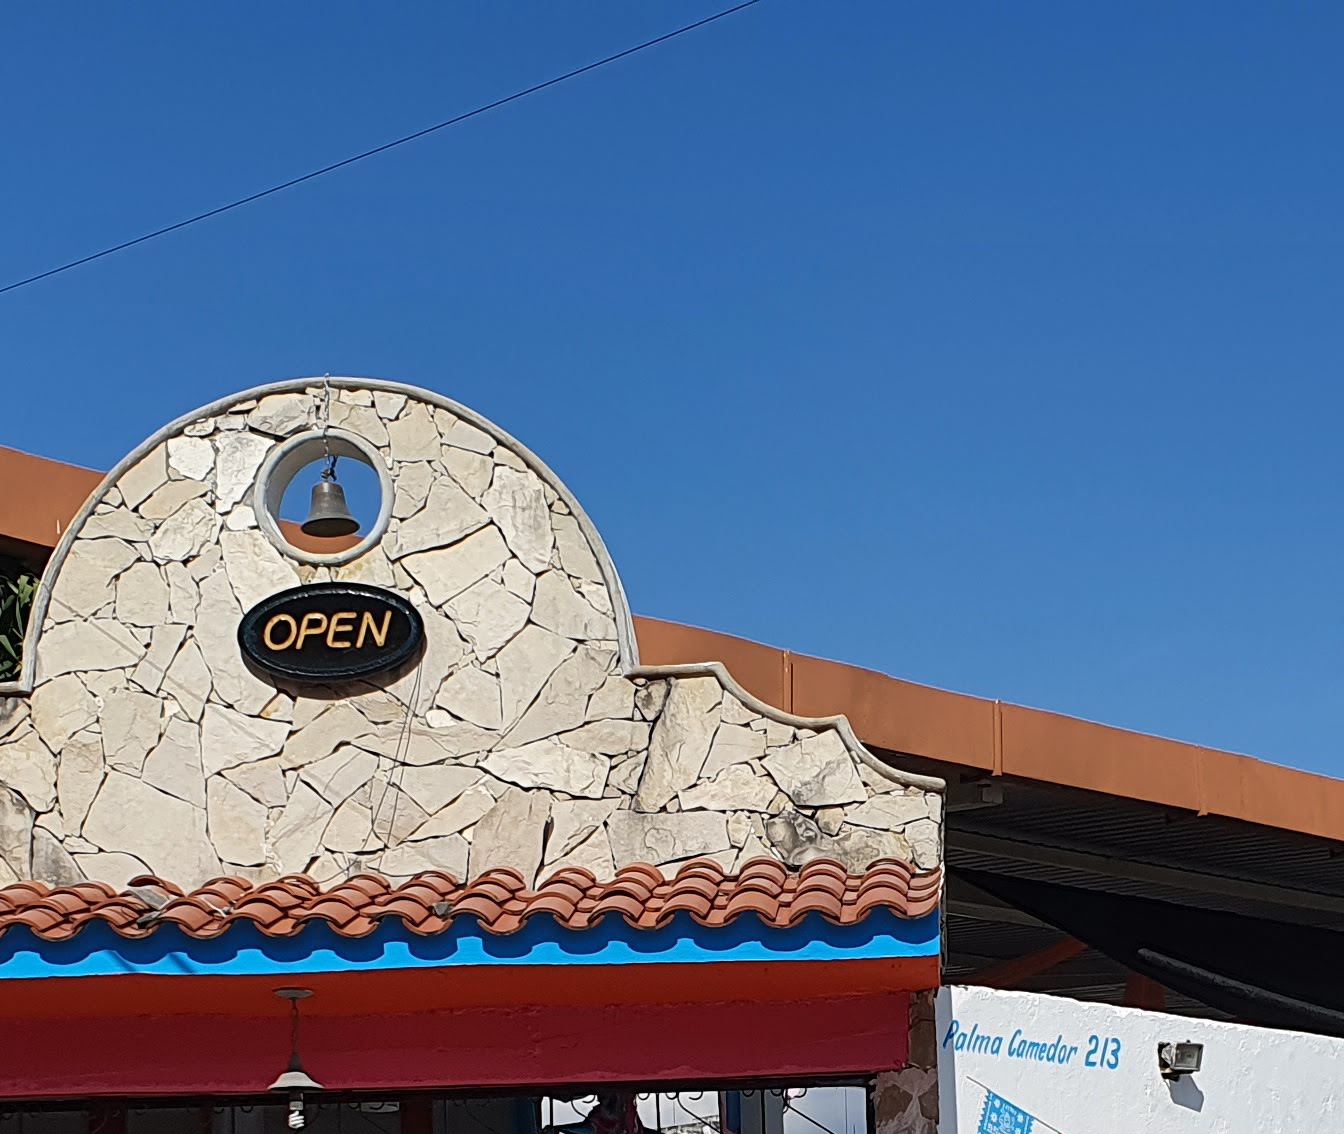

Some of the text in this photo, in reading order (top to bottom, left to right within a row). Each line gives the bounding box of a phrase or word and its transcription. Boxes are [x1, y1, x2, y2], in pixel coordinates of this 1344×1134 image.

[263, 610, 393, 651] OPEN
[943, 1019, 1122, 1070] Palma Camedor 213
